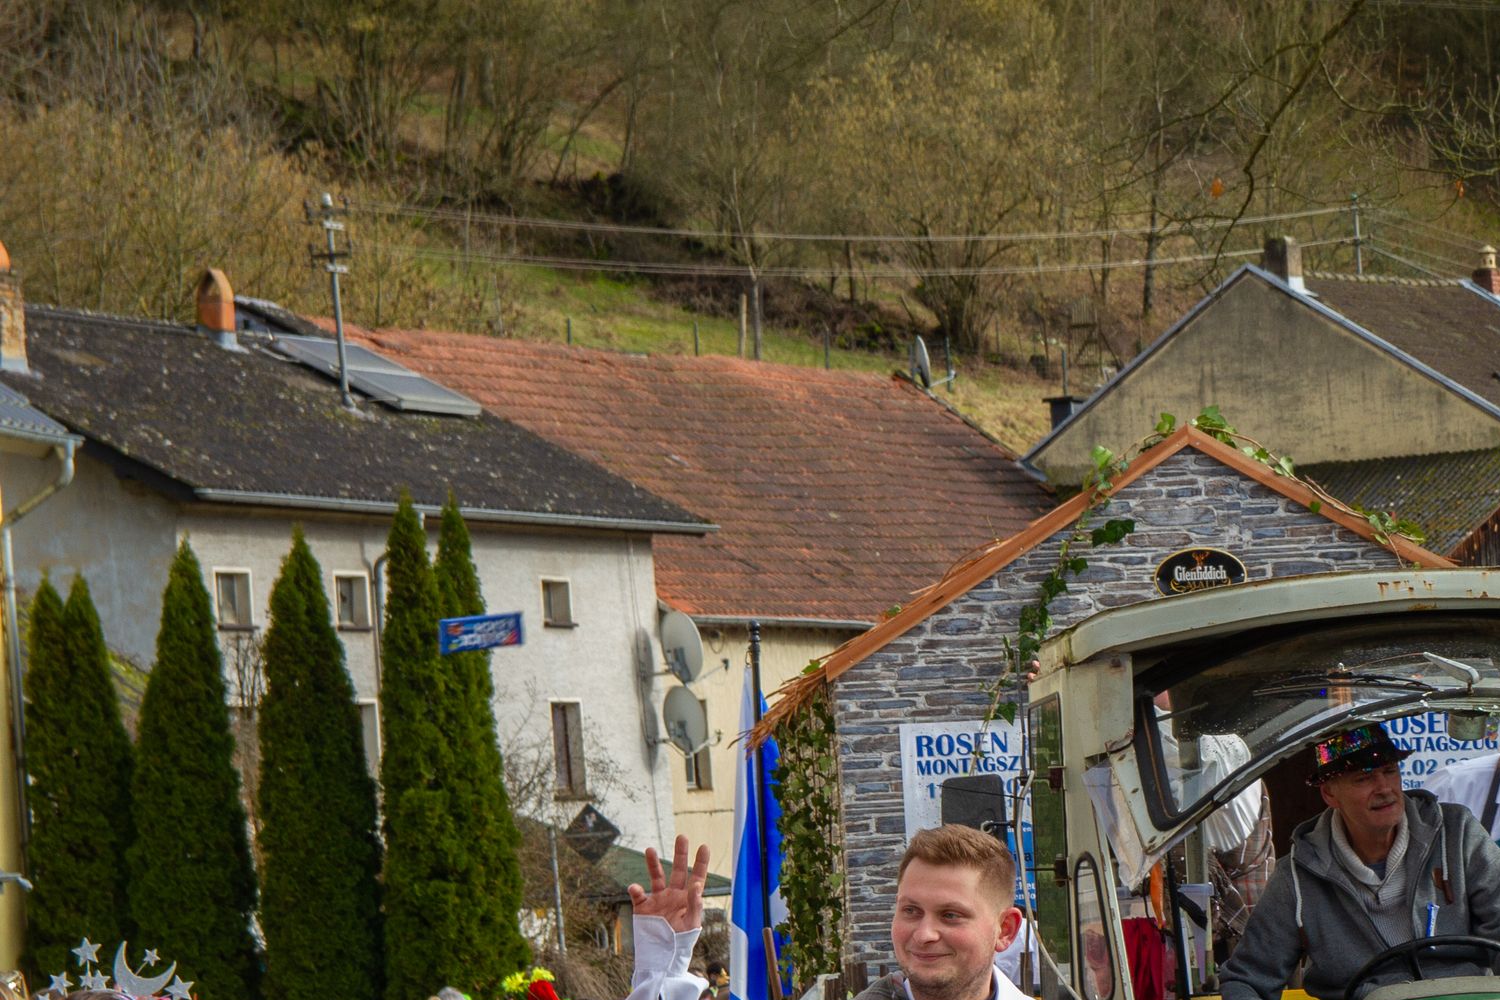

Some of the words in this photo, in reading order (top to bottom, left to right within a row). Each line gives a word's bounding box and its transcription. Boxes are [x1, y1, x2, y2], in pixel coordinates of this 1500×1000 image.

[1174, 564, 1227, 581] Glenfiddich
[1380, 711, 1449, 735] OSE
[915, 731, 1008, 758] ROSEN
[916, 755, 1022, 776] MONTAGSZ
